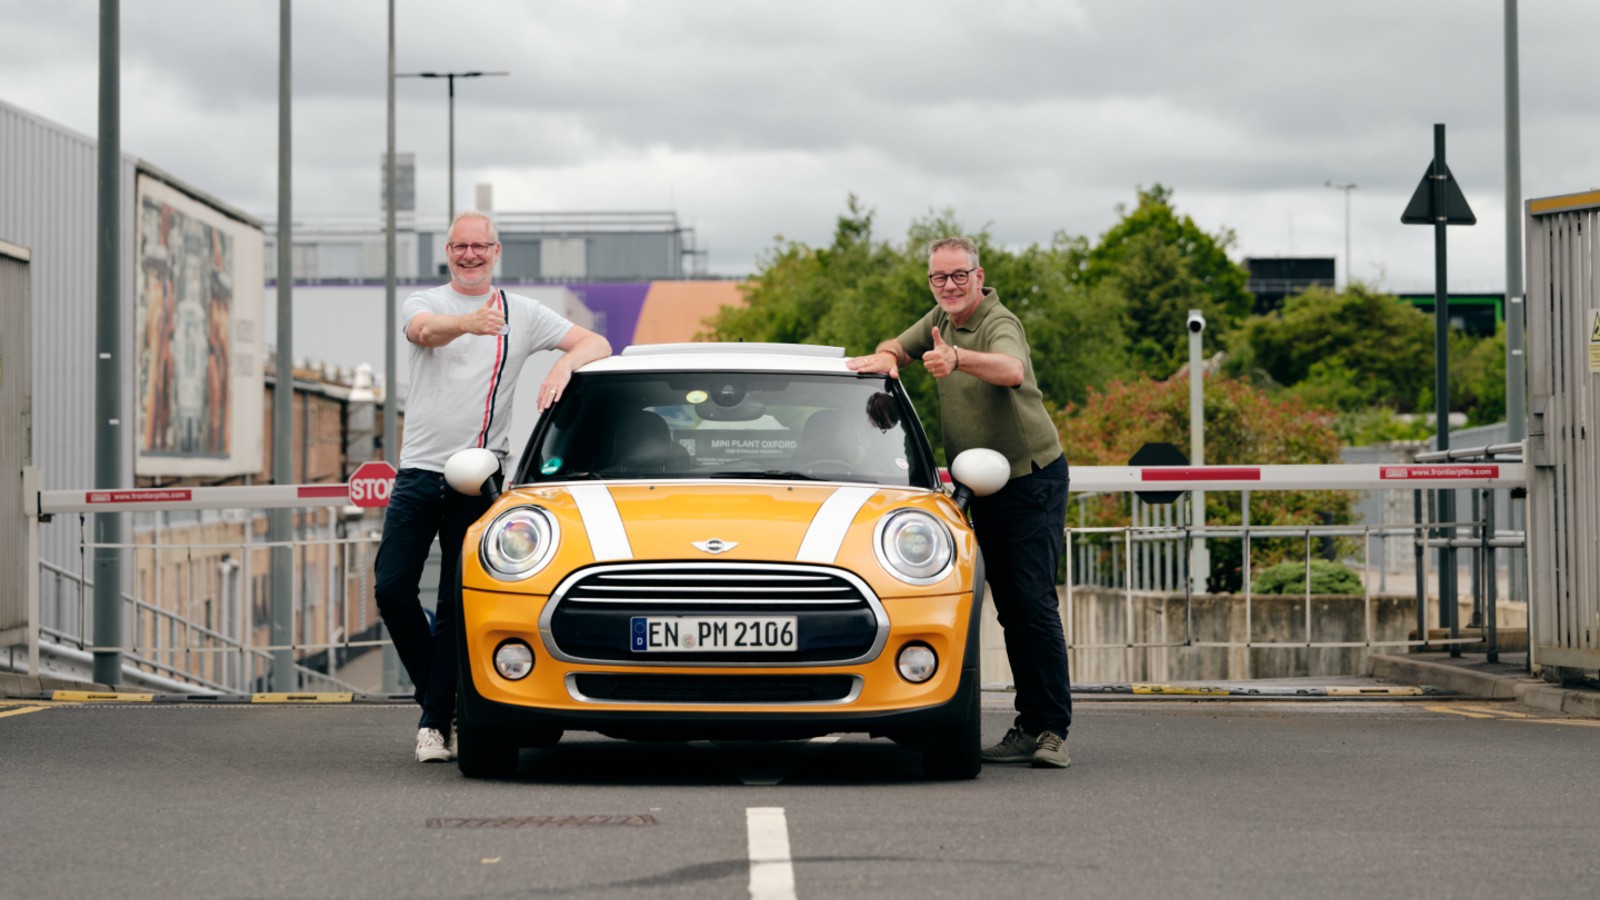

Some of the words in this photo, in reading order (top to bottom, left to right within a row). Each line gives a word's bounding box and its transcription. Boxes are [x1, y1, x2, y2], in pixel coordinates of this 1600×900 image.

[711, 439, 730, 448] MINI
[731, 439, 760, 448] PLANT
[761, 440, 797, 449] OXFORD
[1411, 468, 1492, 478] www.frontierpitts.com
[649, 622, 679, 647] EN
[698, 622, 728, 647] PM
[734, 622, 794, 647] 2106
[636, 637, 643, 646] D
